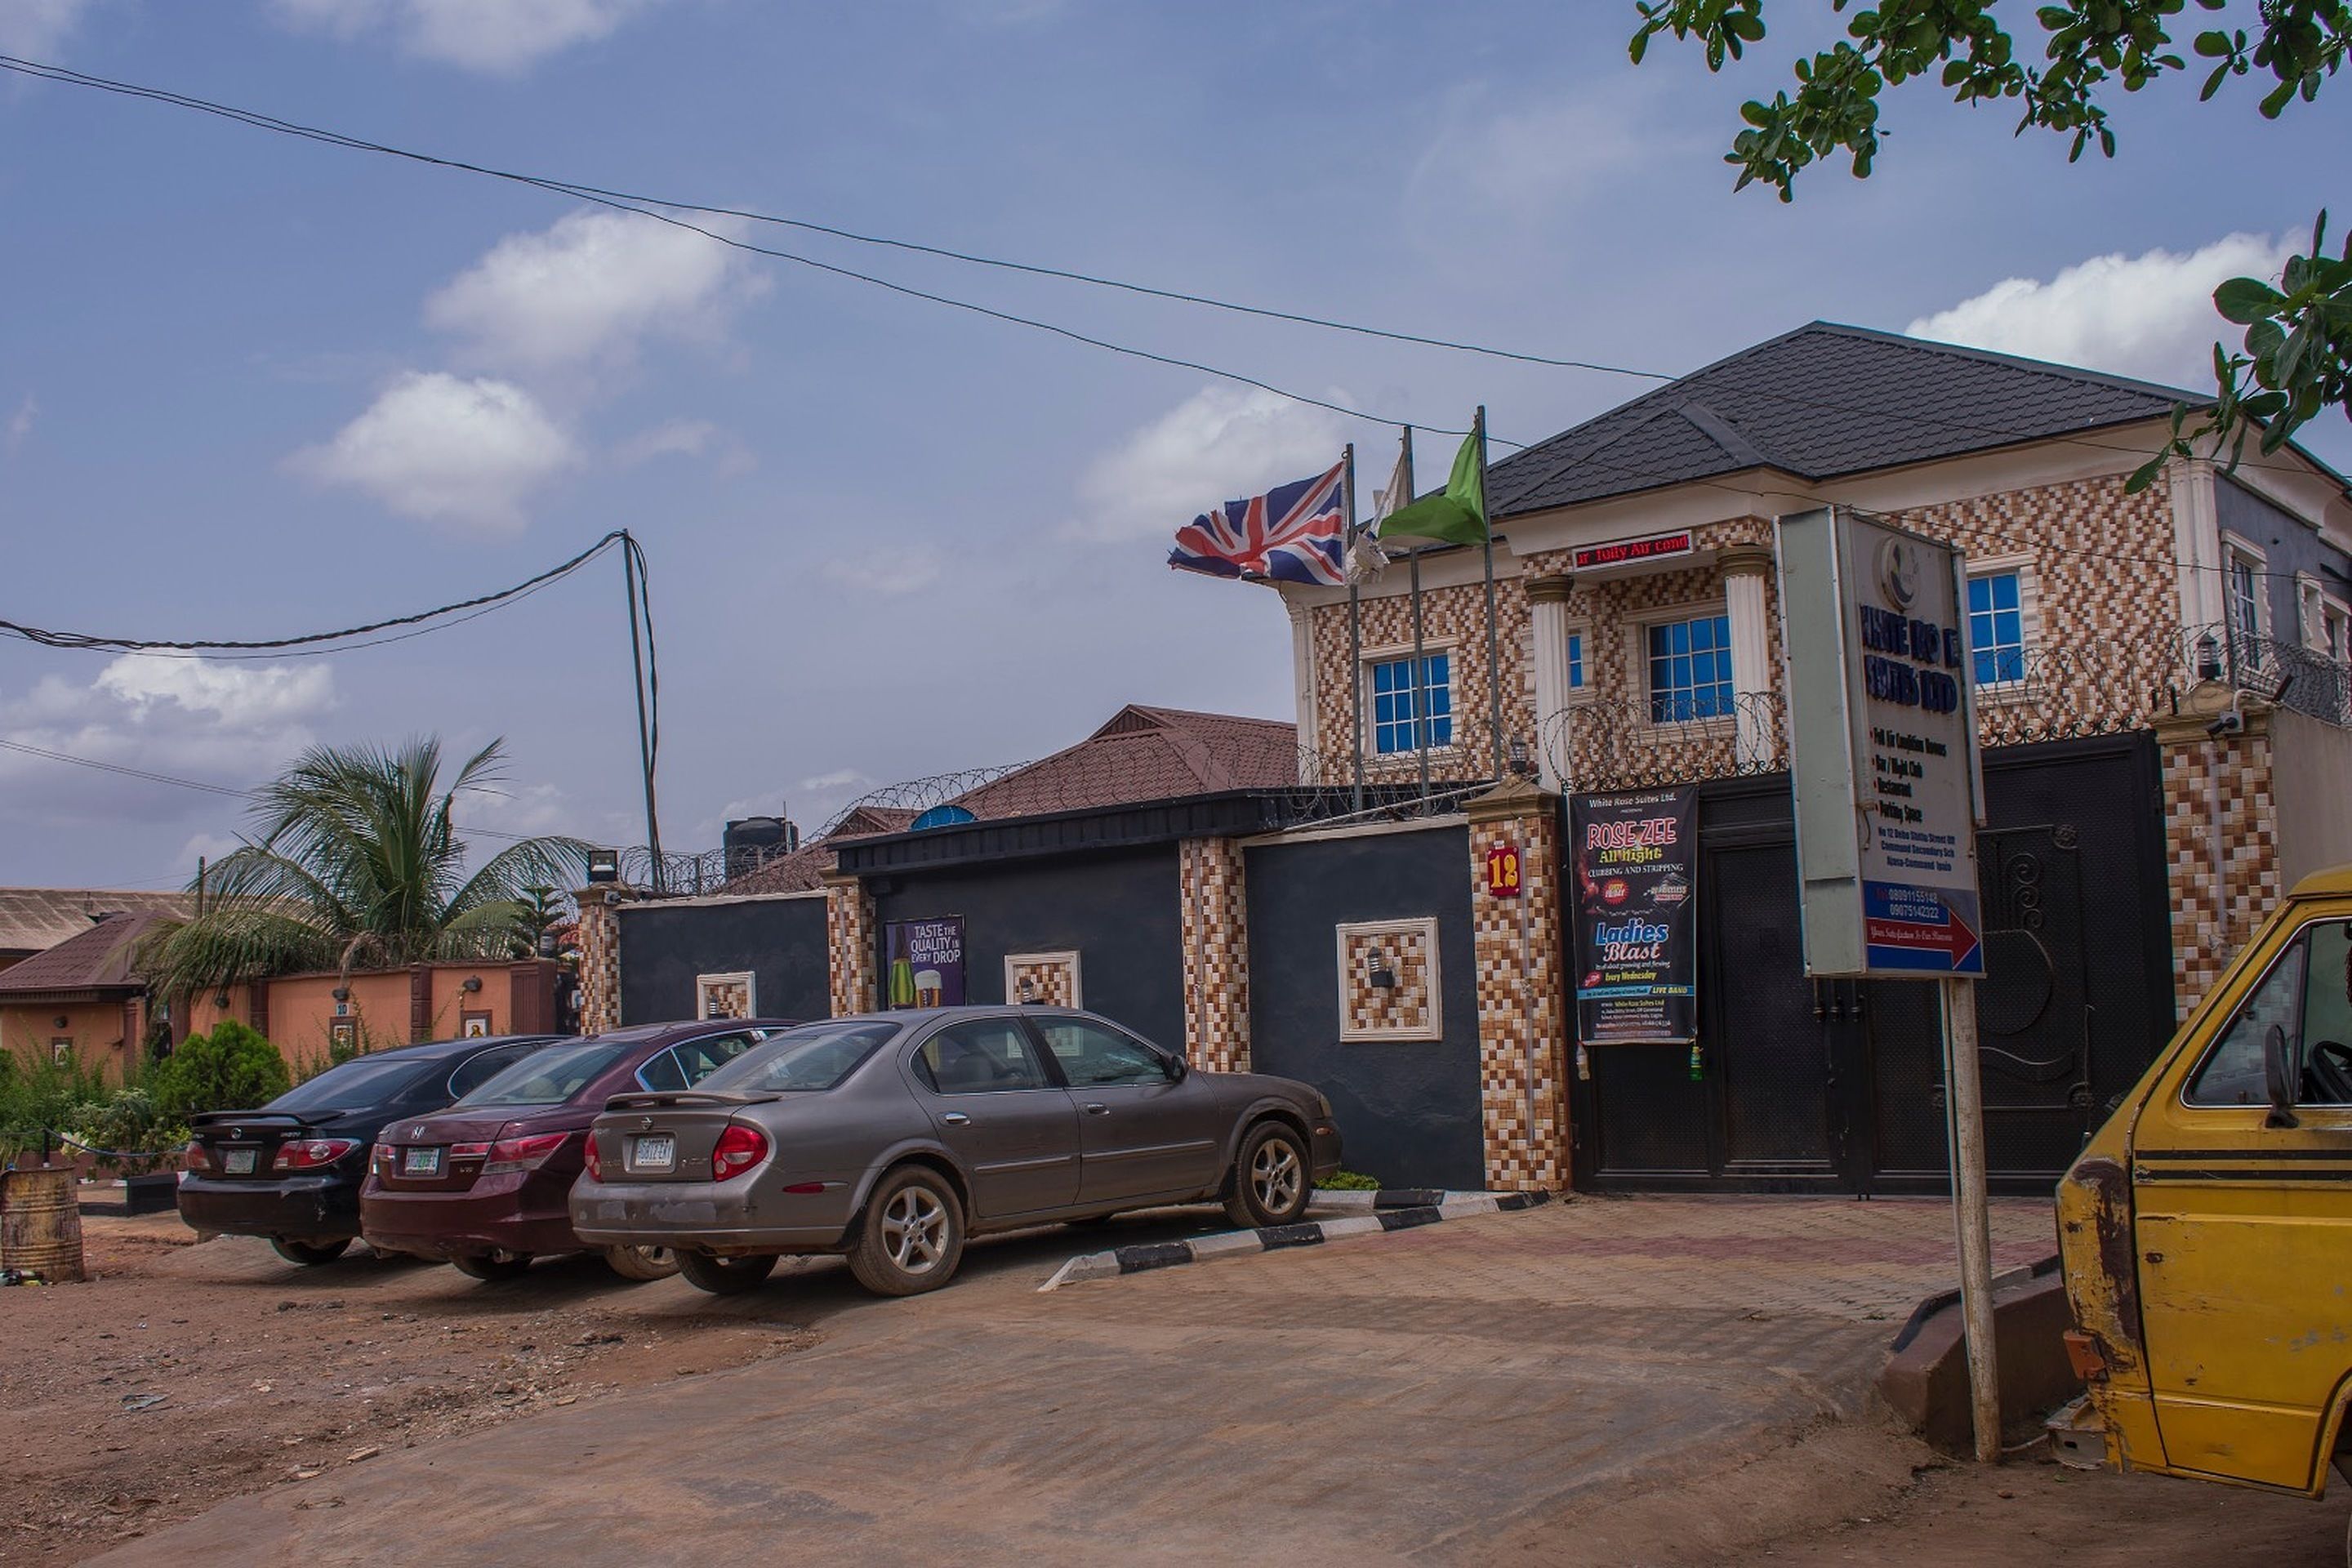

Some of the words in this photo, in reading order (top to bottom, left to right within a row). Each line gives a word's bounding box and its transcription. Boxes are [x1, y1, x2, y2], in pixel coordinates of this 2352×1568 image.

[1631, 542, 1651, 556] Air
[1589, 799, 1612, 808] White
[1615, 797, 1633, 806] Rose
[1635, 795, 1659, 804] Suites
[1587, 821, 1637, 850] ROSE
[1640, 817, 1677, 845] ZEE
[1588, 869, 1623, 878] CLUBBING
[1624, 866, 1642, 875] AND
[1642, 863, 1683, 874] STRIPPING
[915, 924, 943, 938] TASTE
[944, 926, 956, 936] THE
[1596, 917, 1668, 946] Ladies
[911, 936, 951, 954] QUALITY
[951, 939, 960, 948] IN
[1603, 942, 1660, 962] Blast
[911, 952, 931, 963] EVERY
[933, 949, 960, 964] DROP
[1605, 973, 1620, 982] Every
[1621, 970, 1657, 981] Wednesday
